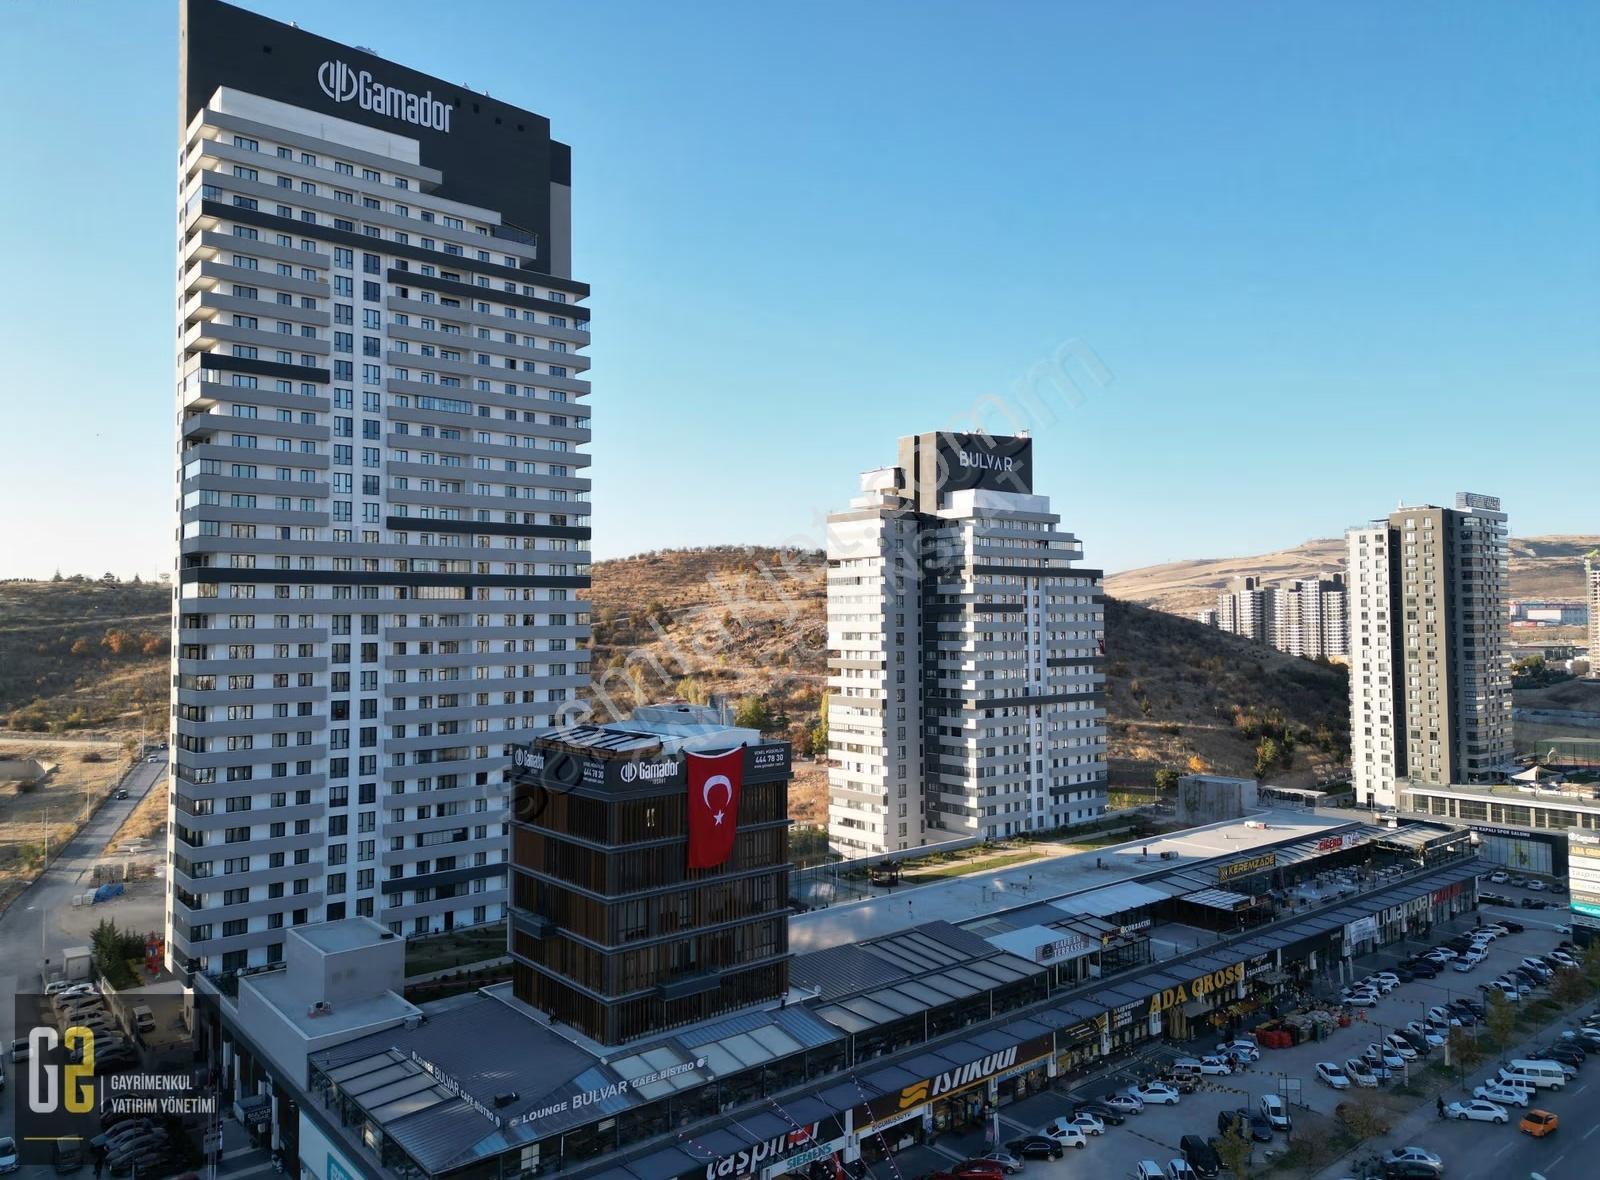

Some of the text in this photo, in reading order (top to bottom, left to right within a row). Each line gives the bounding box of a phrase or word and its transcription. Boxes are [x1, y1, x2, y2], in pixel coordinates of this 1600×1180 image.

[359, 70, 453, 133] Gamador
[960, 450, 1012, 472] BULVAR
[638, 759, 680, 779] Gamador
[1228, 855, 1275, 876] KEREMZADE
[1150, 985, 1188, 1012] ADA
[1191, 961, 1244, 998] GROSS
[434, 1066, 460, 1096] BULVAR
[460, 1089, 474, 1105] CAFE
[522, 1102, 568, 1123] LOUNGE
[572, 1081, 628, 1109] BULVAR
[632, 1072, 658, 1088] CAFE
[786, 1143, 833, 1170] SIEMENS
